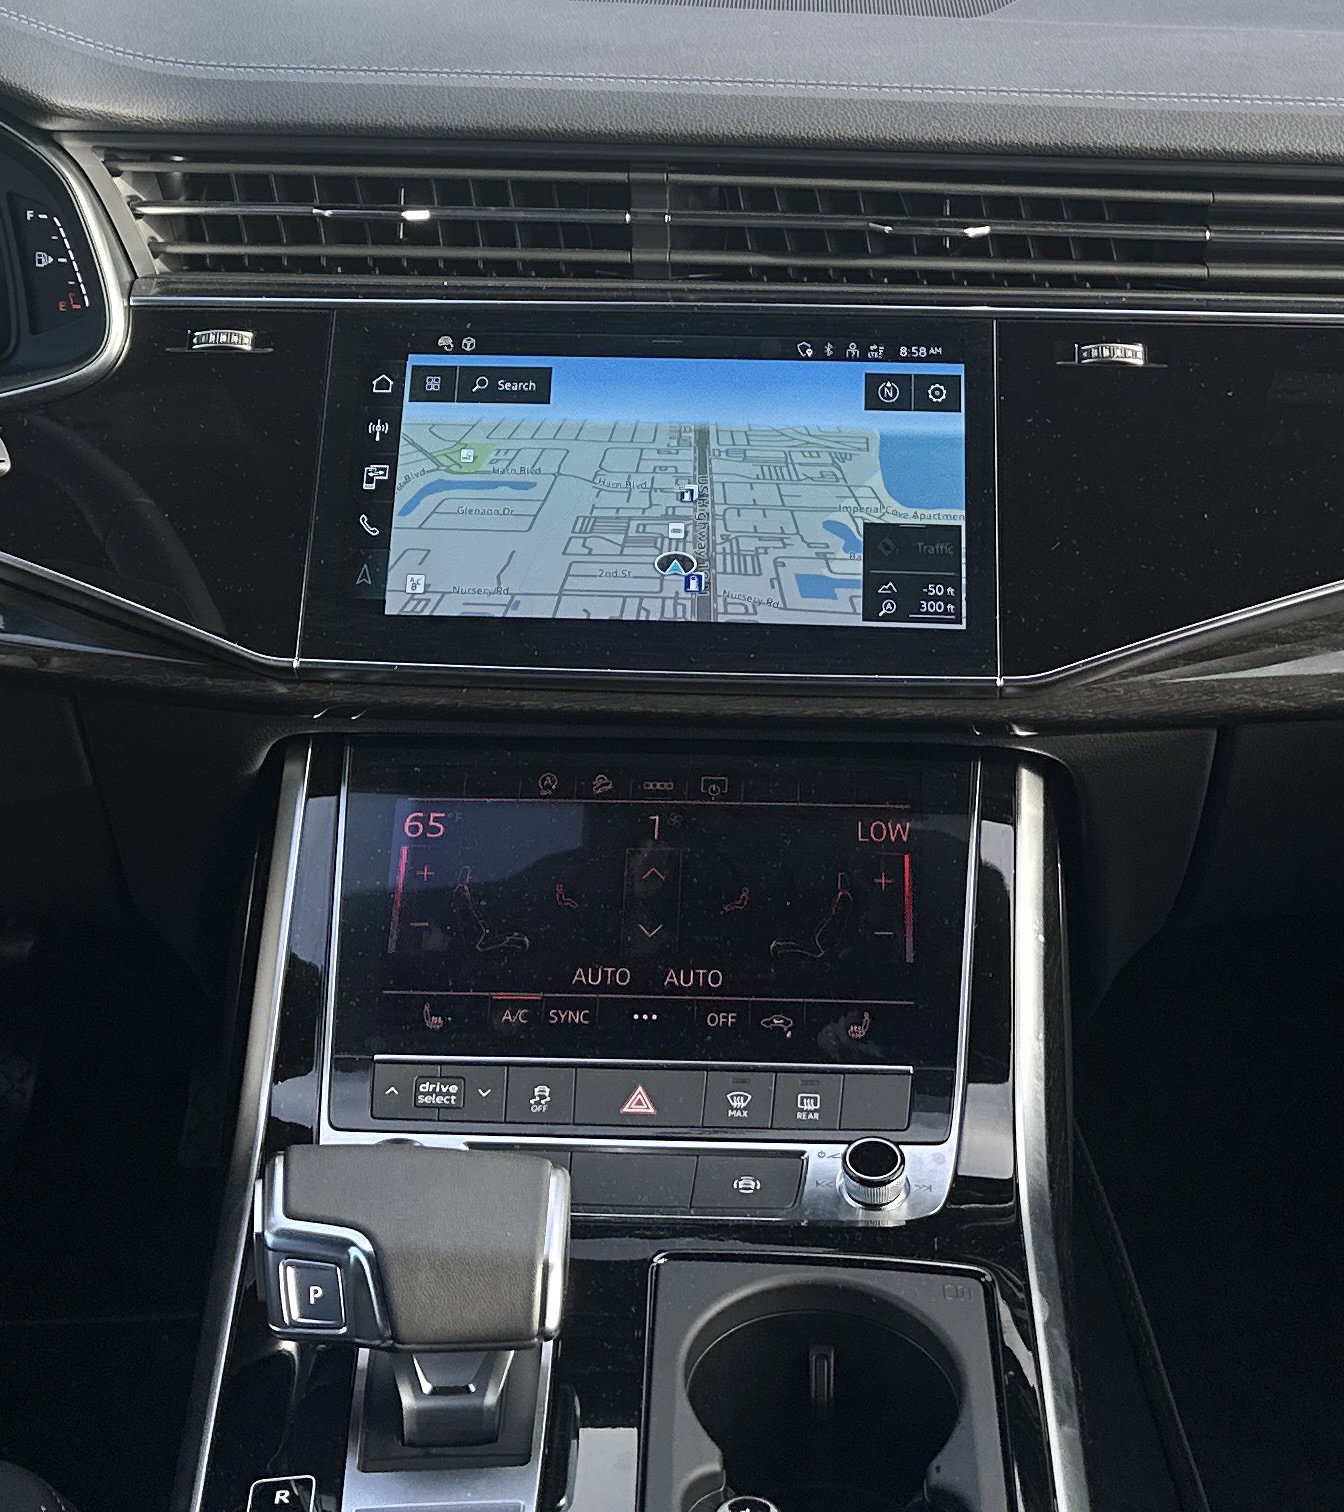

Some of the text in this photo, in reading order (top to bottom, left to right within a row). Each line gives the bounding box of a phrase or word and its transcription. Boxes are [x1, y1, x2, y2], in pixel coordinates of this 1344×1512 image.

[26, 210, 35, 220] F
[899, 346, 943, 358] 8:58 AM
[497, 379, 536, 392] Search
[503, 507, 515, 517] Dr
[838, 503, 884, 517] Imperial
[695, 499, 710, 557] Highway
[917, 541, 955, 556] Traffic
[922, 584, 956, 597] -50 ft
[919, 601, 956, 614] 300 ft
[404, 811, 446, 838] 65
[858, 819, 911, 842] LOW
[571, 967, 723, 987] AUTO AUTO
[501, 1008, 590, 1025] A/C SYNC
[706, 1013, 737, 1027] OFF
[419, 1081, 459, 1094] drive
[417, 1093, 457, 1106] select
[530, 1104, 549, 1113] OFF
[728, 1109, 748, 1118] MAX
[796, 1111, 820, 1121] REAR
[308, 1285, 324, 1305] P
[273, 1489, 291, 1505] R
